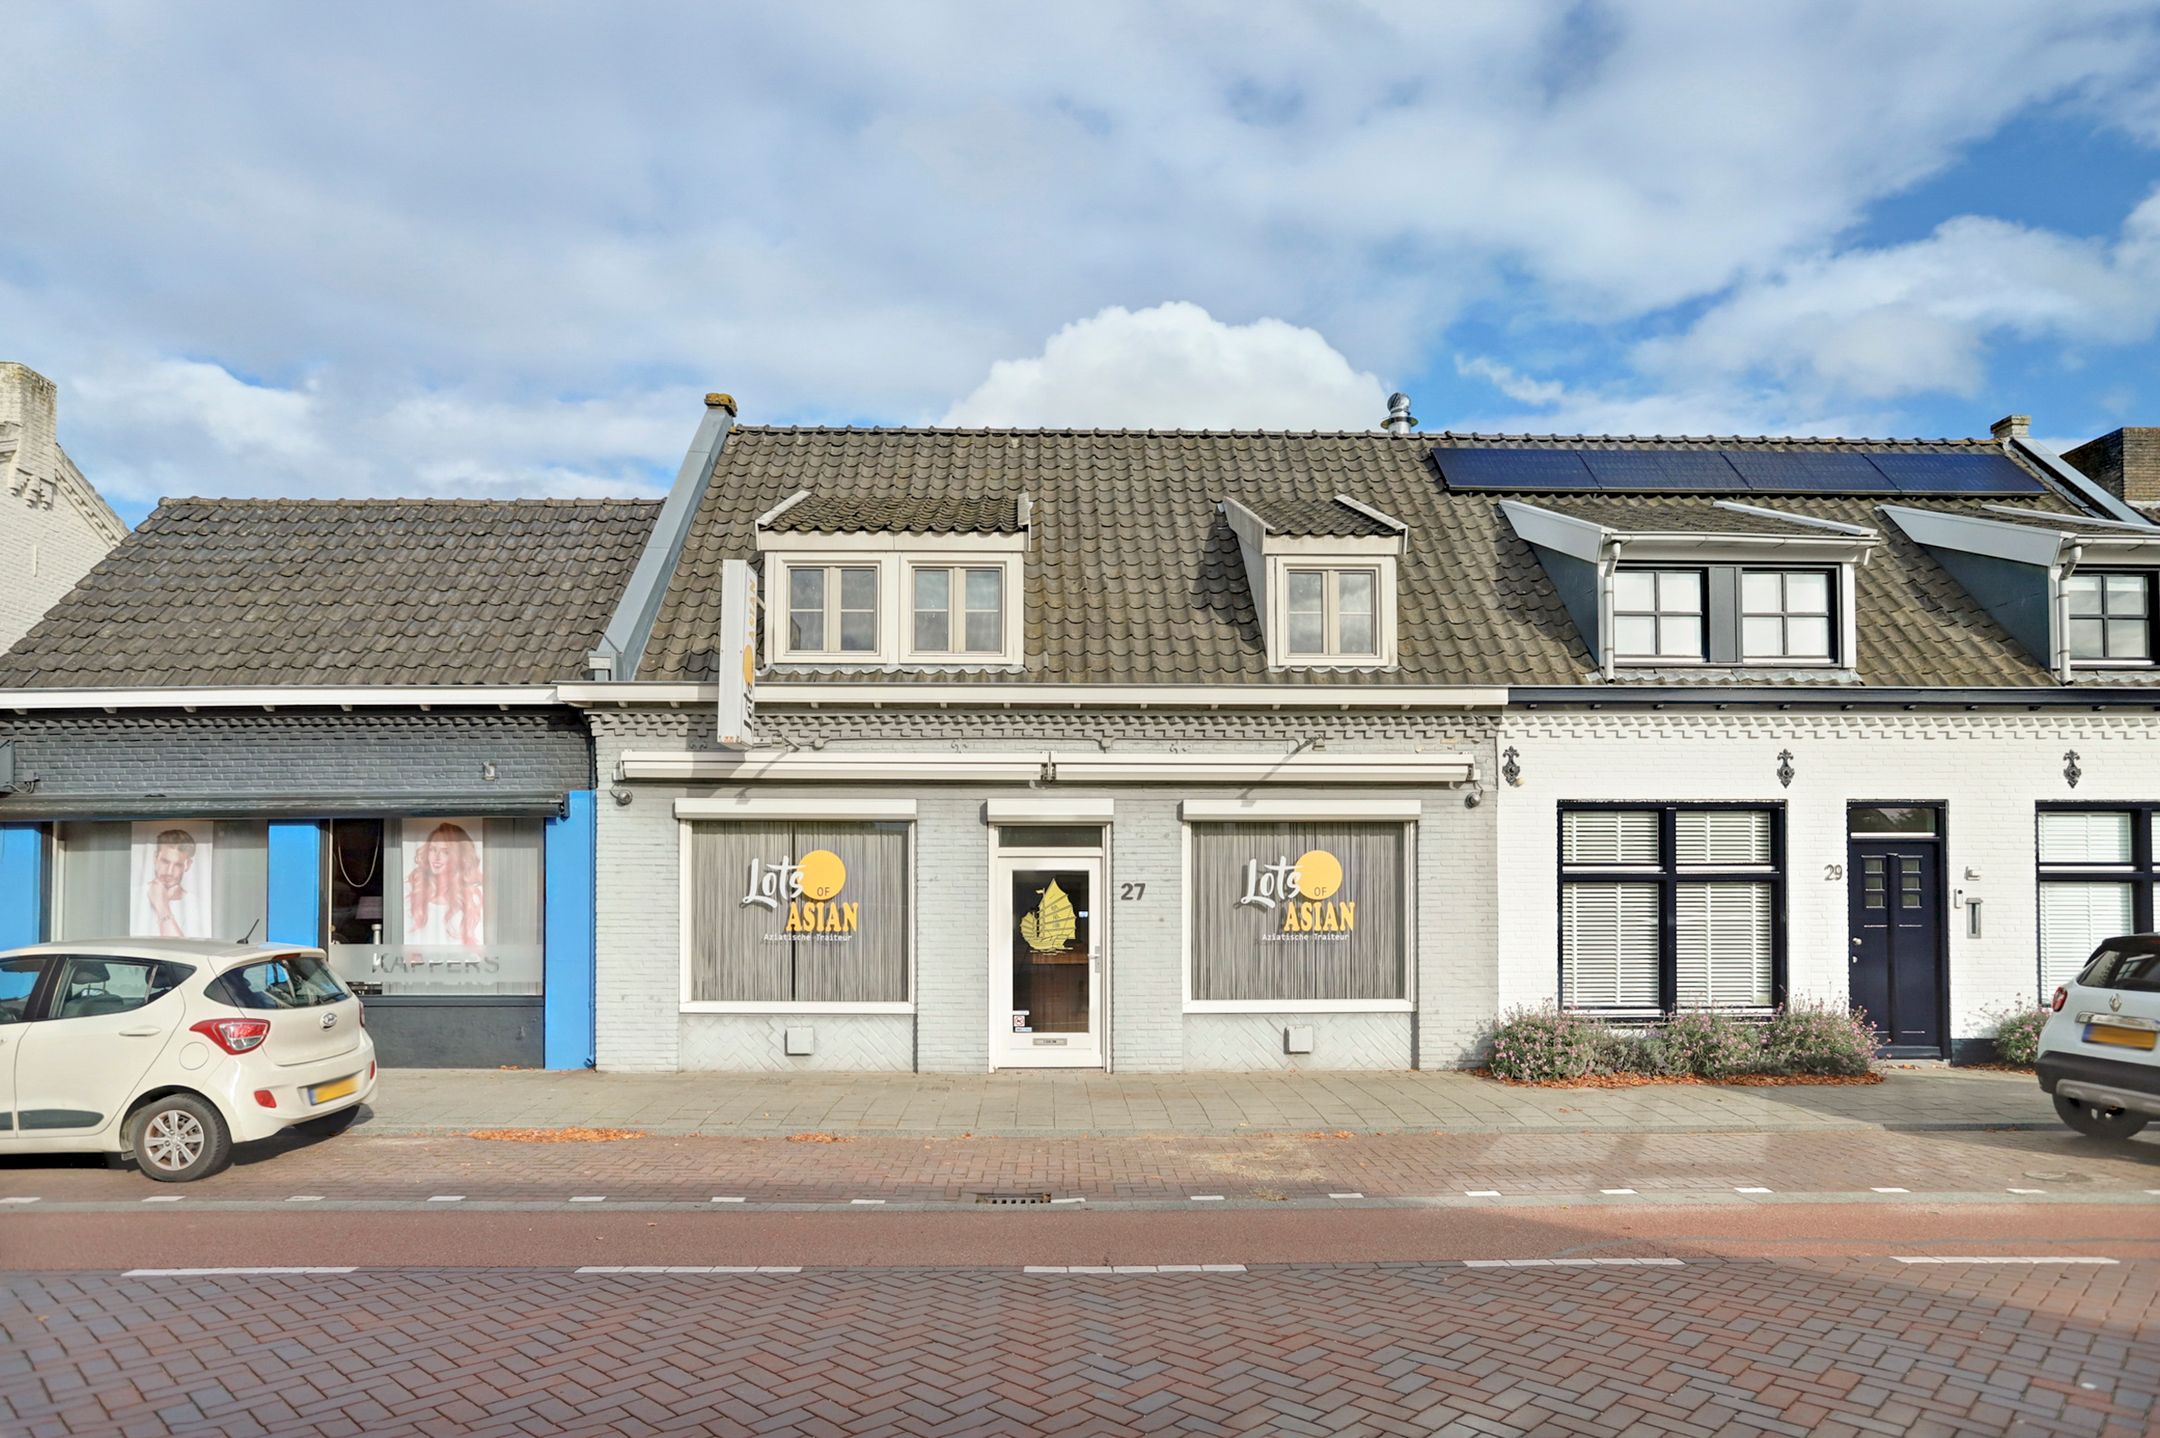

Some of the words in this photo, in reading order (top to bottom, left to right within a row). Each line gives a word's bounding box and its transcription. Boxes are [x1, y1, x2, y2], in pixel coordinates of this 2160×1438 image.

[742, 855, 806, 908] Lots
[1240, 855, 1303, 908] Lots
[1824, 864, 1842, 881] 29
[816, 886, 831, 897] OF
[1120, 882, 1146, 901] 27
[1313, 886, 1327, 897] OF
[785, 901, 859, 932] ASIAN
[1283, 901, 1355, 932] ASIAN
[763, 933, 811, 942] Aziatische
[816, 933, 853, 942] Traiteur
[1262, 933, 1309, 942] Aziatische
[1313, 933, 1350, 942] Traiteur
[371, 952, 500, 974] KAPPERS
